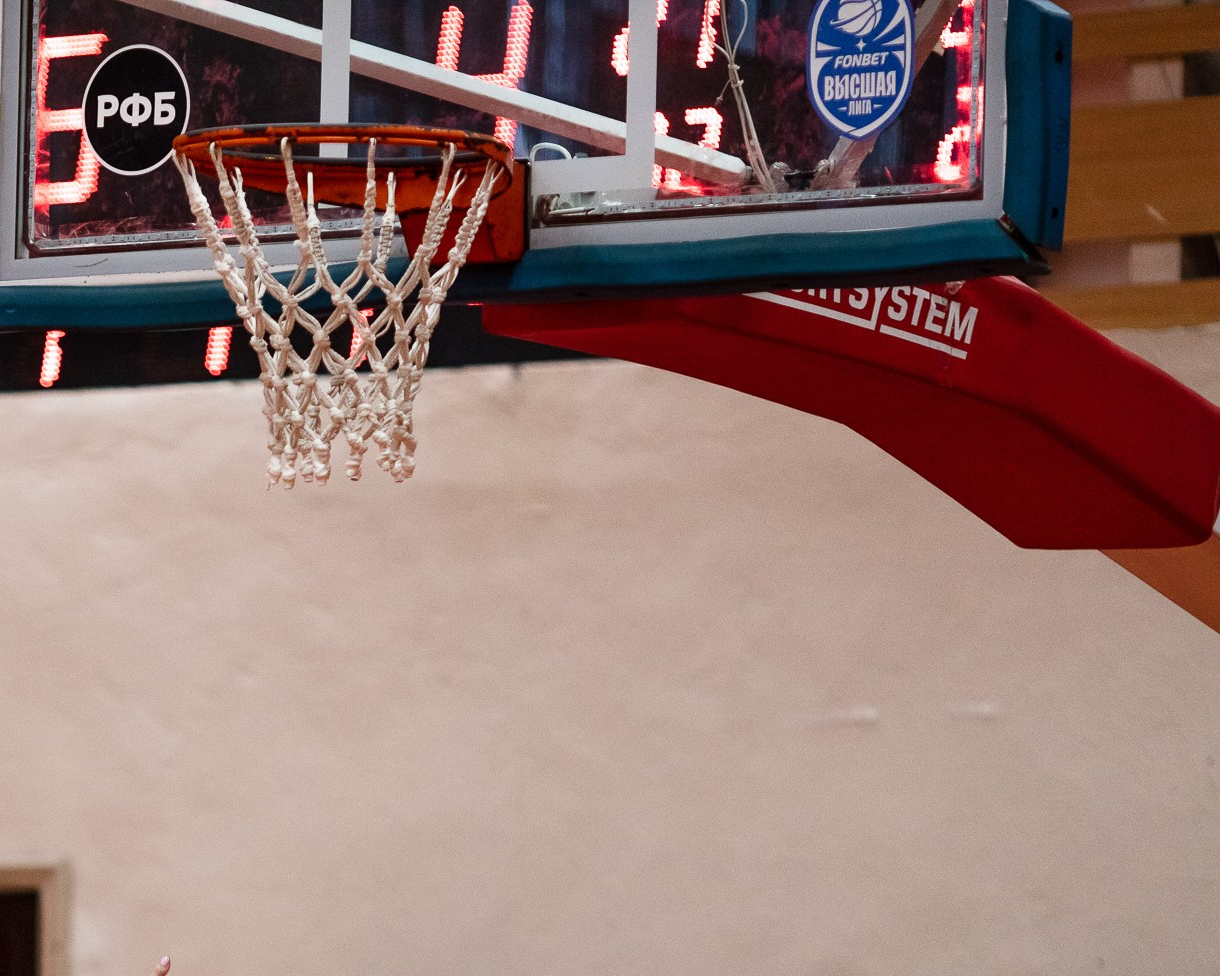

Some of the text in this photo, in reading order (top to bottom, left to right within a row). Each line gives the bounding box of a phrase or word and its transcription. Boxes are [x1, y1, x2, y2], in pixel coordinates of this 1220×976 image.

[834, 51, 890, 69] FONBET
[824, 70, 897, 101] ВЫСШАЯ
[96, 91, 176, 128] РФБ
[848, 99, 872, 116] ЛИГА
